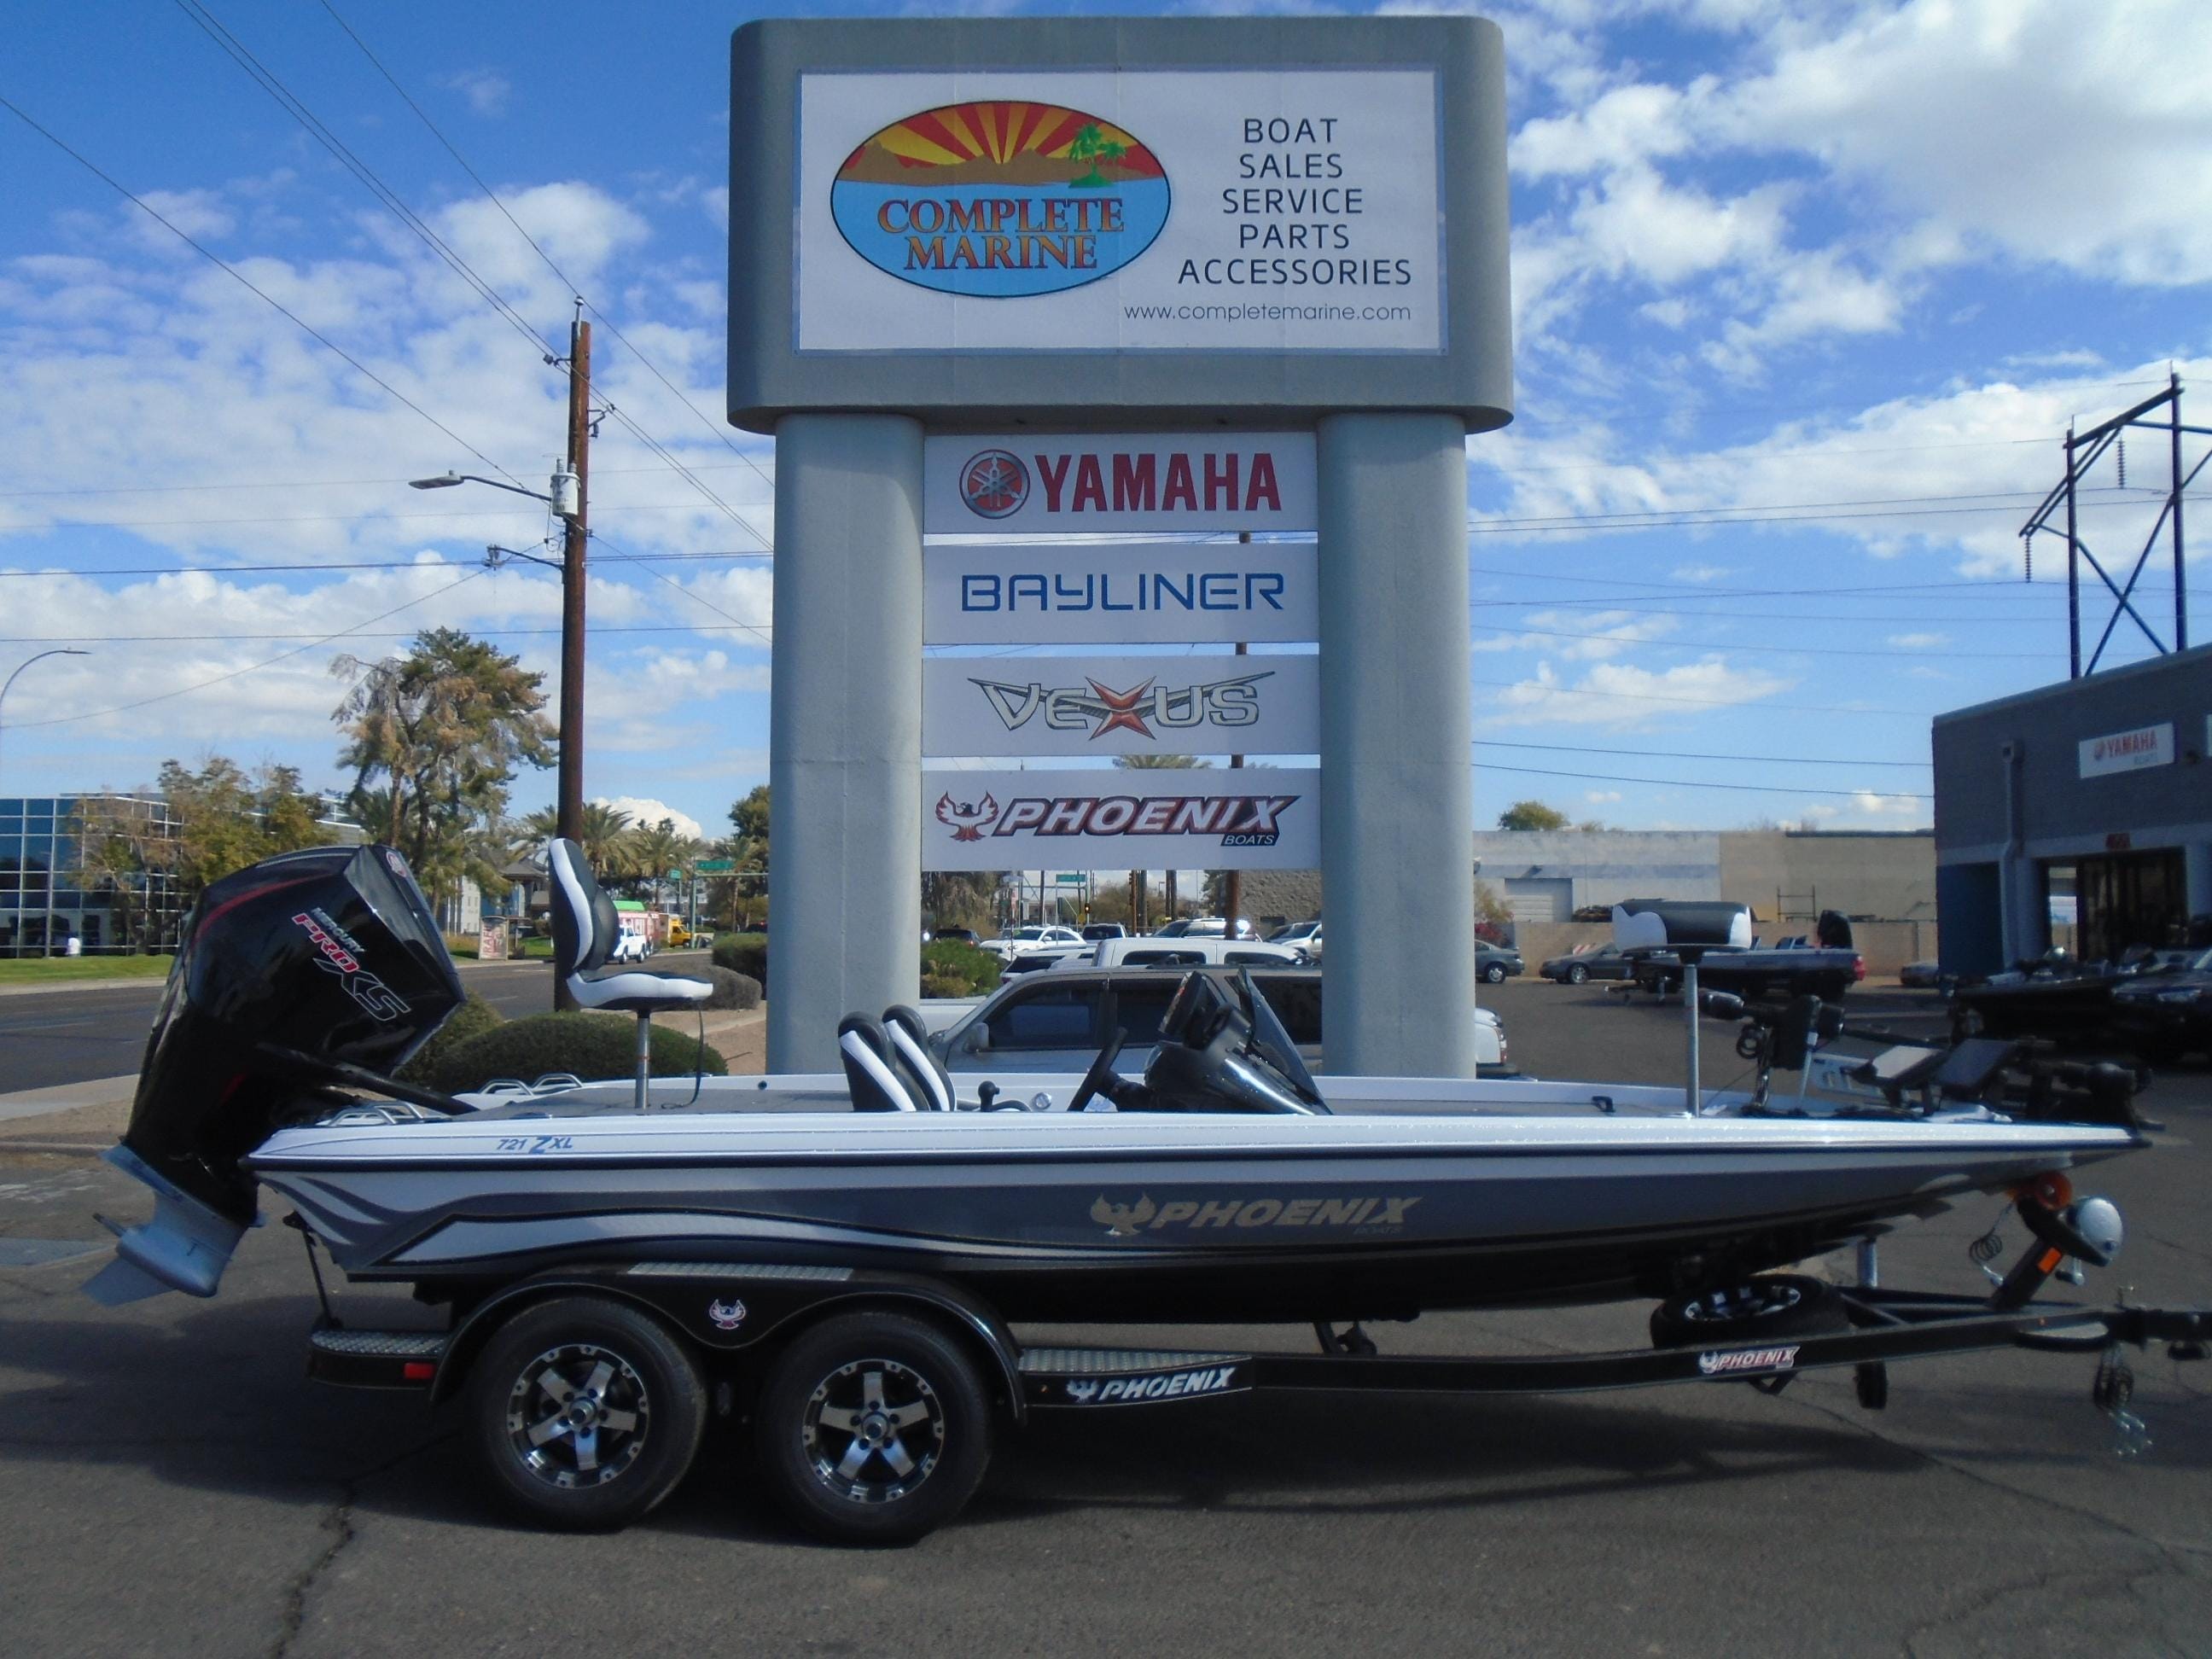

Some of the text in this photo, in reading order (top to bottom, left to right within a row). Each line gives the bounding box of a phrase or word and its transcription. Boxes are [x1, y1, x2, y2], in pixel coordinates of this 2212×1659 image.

[1243, 118, 1339, 144] BOAT
[1239, 154, 1344, 180] SALES
[876, 197, 1125, 234] COMPLETE
[1222, 189, 1364, 215] SERVICE
[1239, 224, 1350, 250] PARTS
[904, 234, 1098, 271] MARINE
[1178, 259, 1412, 287] ACCESSORIES
[1124, 304, 1412, 323] www.completemarine.com
[1034, 453, 1282, 513] YAMAHA
[962, 573, 1285, 612] BAYLINER
[2107, 730, 2158, 758] YAMAHA
[992, 795, 1302, 837] PHOENIX
[1224, 834, 1275, 847] BOATS
[291, 912, 360, 973] PRO
[312, 957, 411, 1022] XS
[496, 1138, 528, 1150] 721
[1149, 1196, 1423, 1229] PHOENIX
[1715, 1347, 1799, 1371] PHOENIX
[1098, 1366, 1237, 1401] PHOENIX
